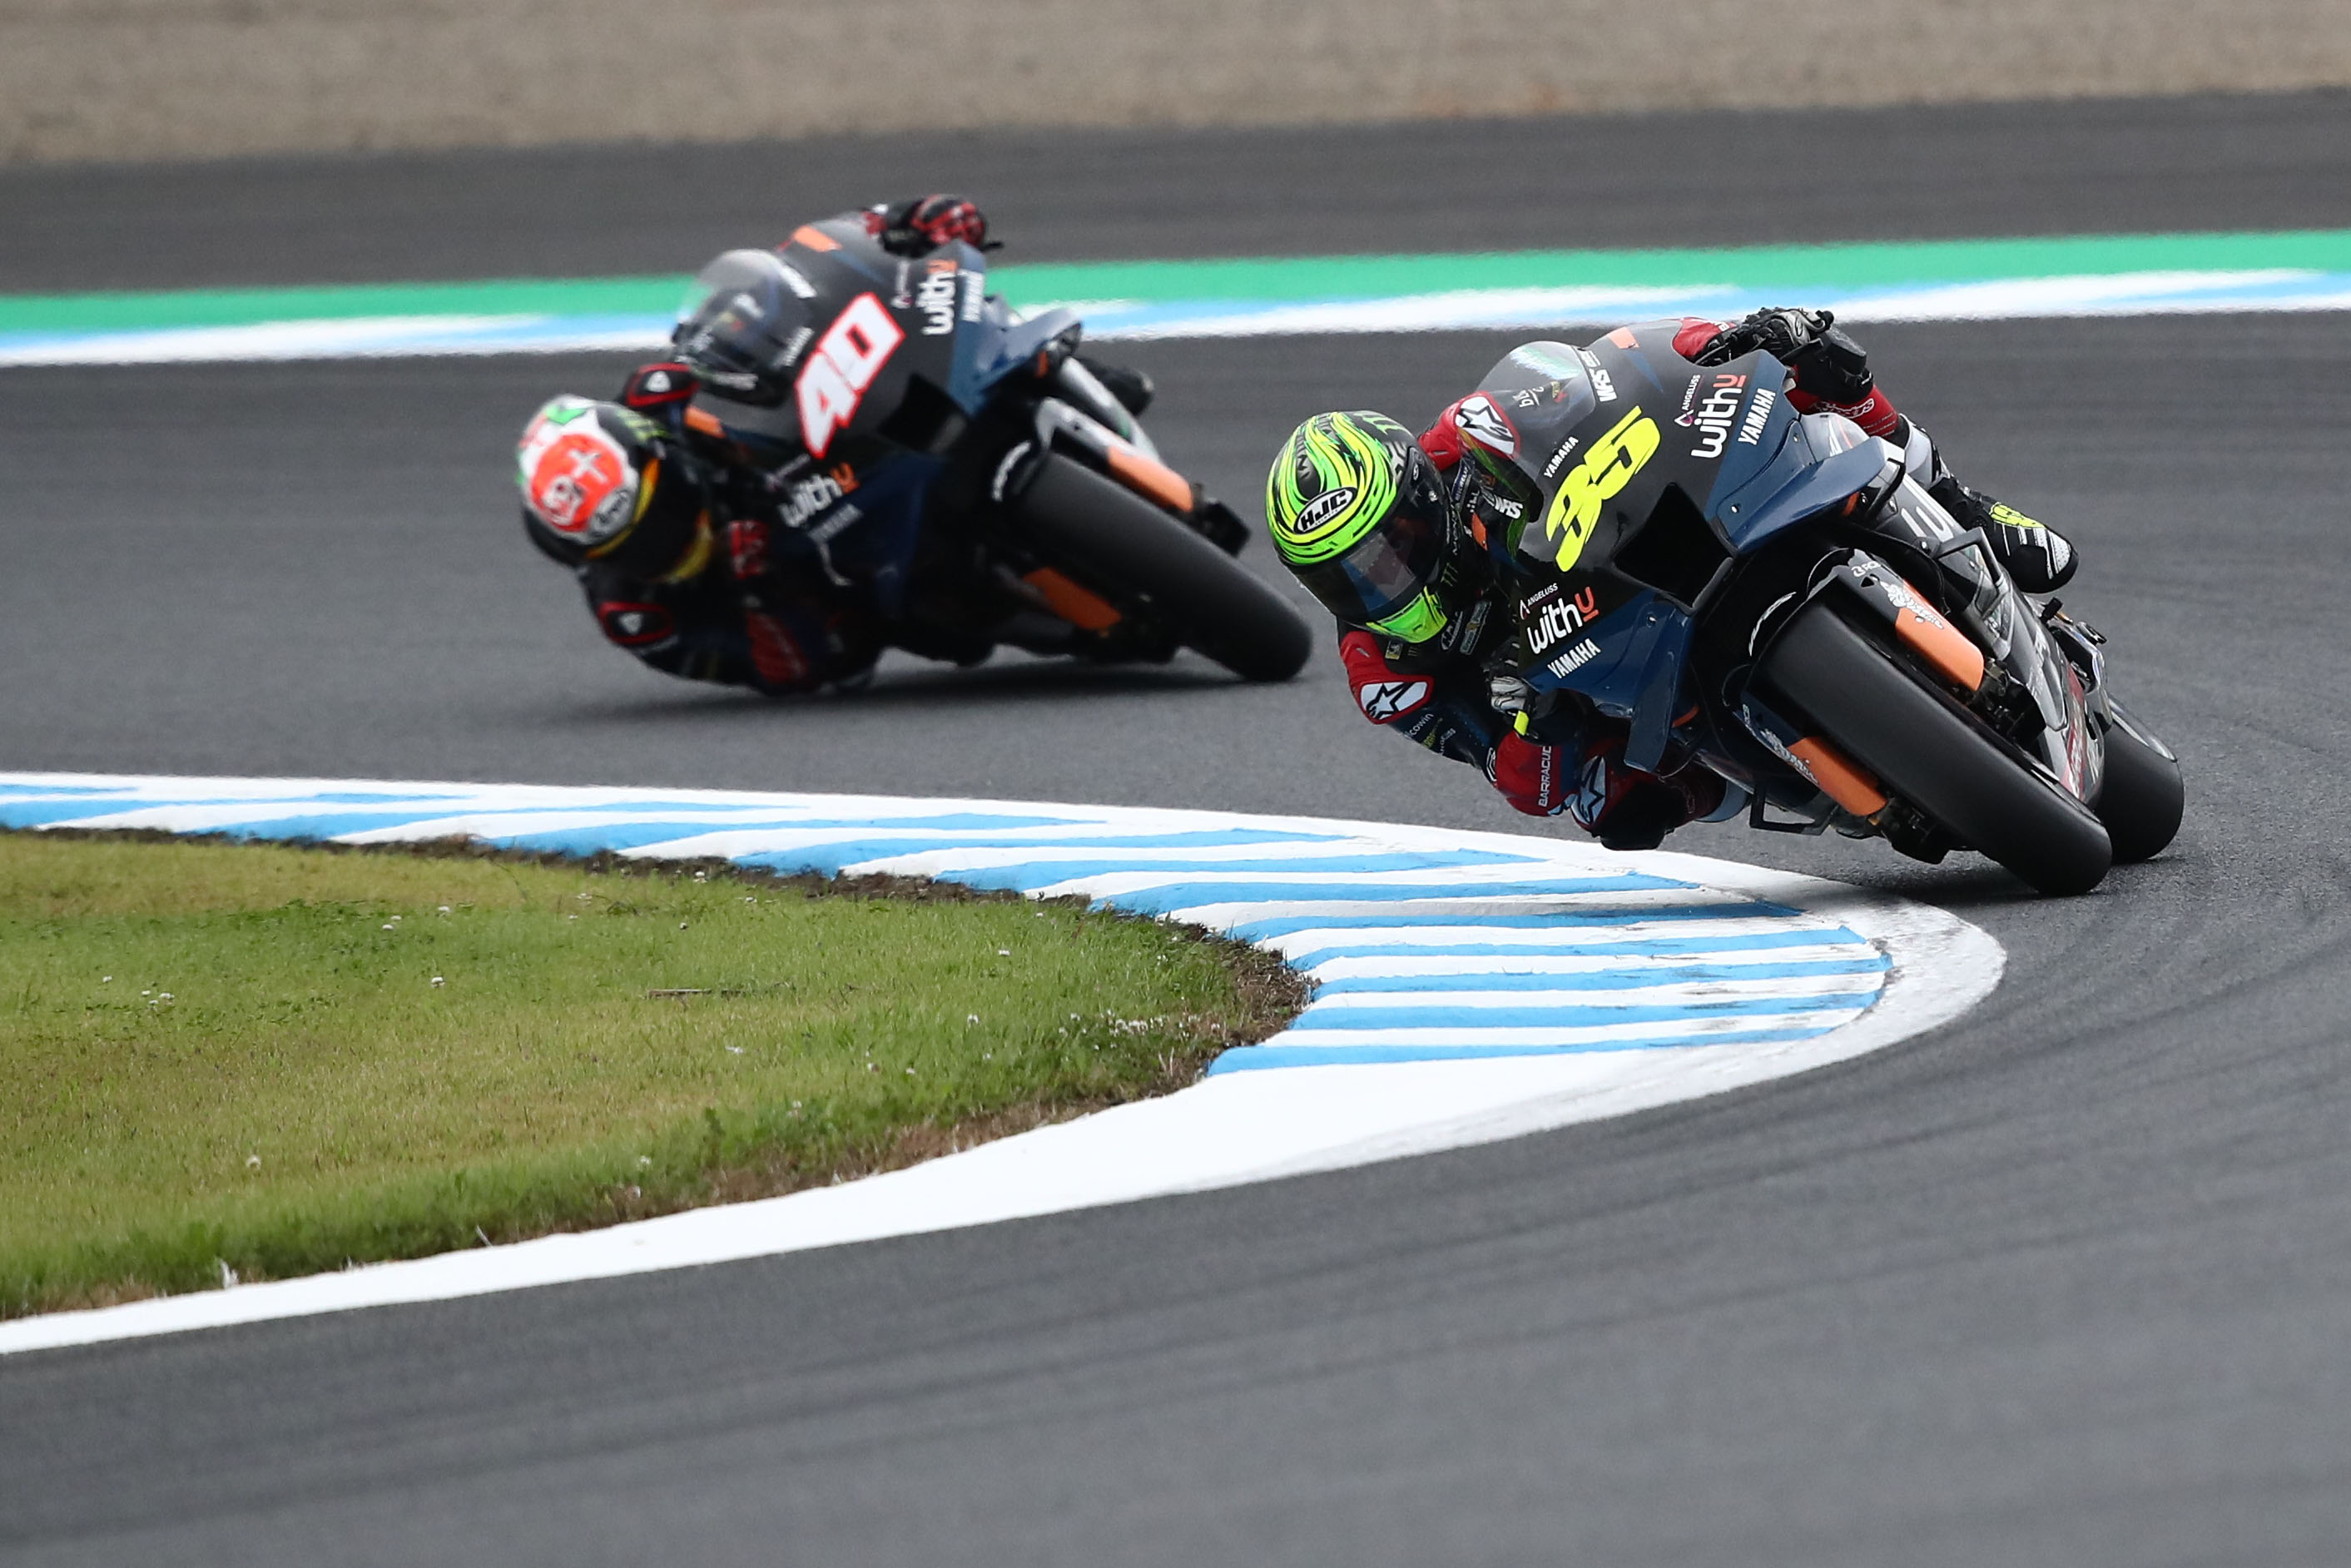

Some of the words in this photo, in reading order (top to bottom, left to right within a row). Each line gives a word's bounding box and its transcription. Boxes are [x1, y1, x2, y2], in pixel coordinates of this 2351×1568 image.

[796, 292, 905, 459] 40
[1738, 388, 1776, 445] YAMAHA
[1544, 435, 1579, 479] YAMAHA
[1300, 490, 1347, 531] HJC
[1546, 405, 1661, 572] 35
[1527, 583, 1559, 607] ANGELUSS
[1547, 638, 1601, 679] YAMAHA
